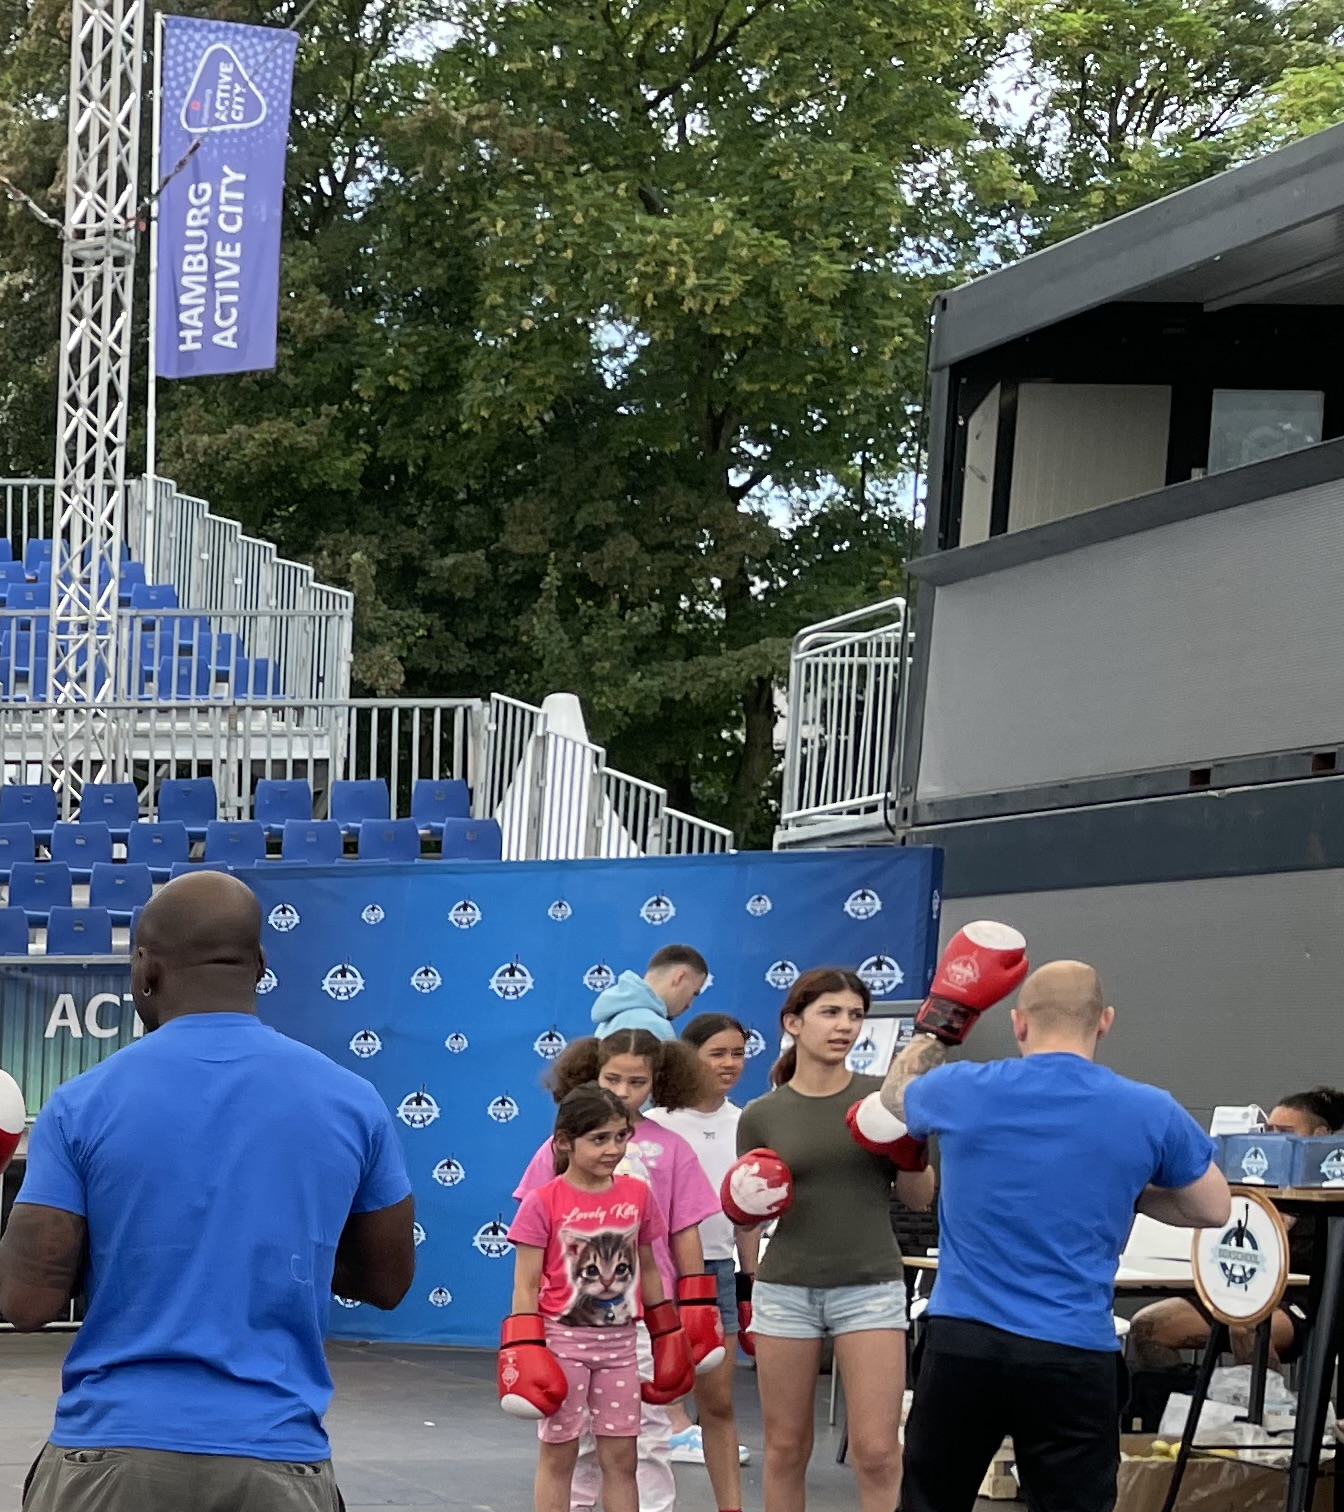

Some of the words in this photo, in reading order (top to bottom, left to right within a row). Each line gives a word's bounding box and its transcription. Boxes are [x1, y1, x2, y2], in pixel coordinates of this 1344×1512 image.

[214, 61, 234, 123] ACTIVE
[231, 83, 249, 122] CITY
[217, 165, 247, 234] CITY
[178, 181, 212, 352] HAMBURG
[212, 240, 242, 350] ACTIVE
[44, 993, 148, 1039] ACT
[561, 1206, 607, 1227] Lovely
